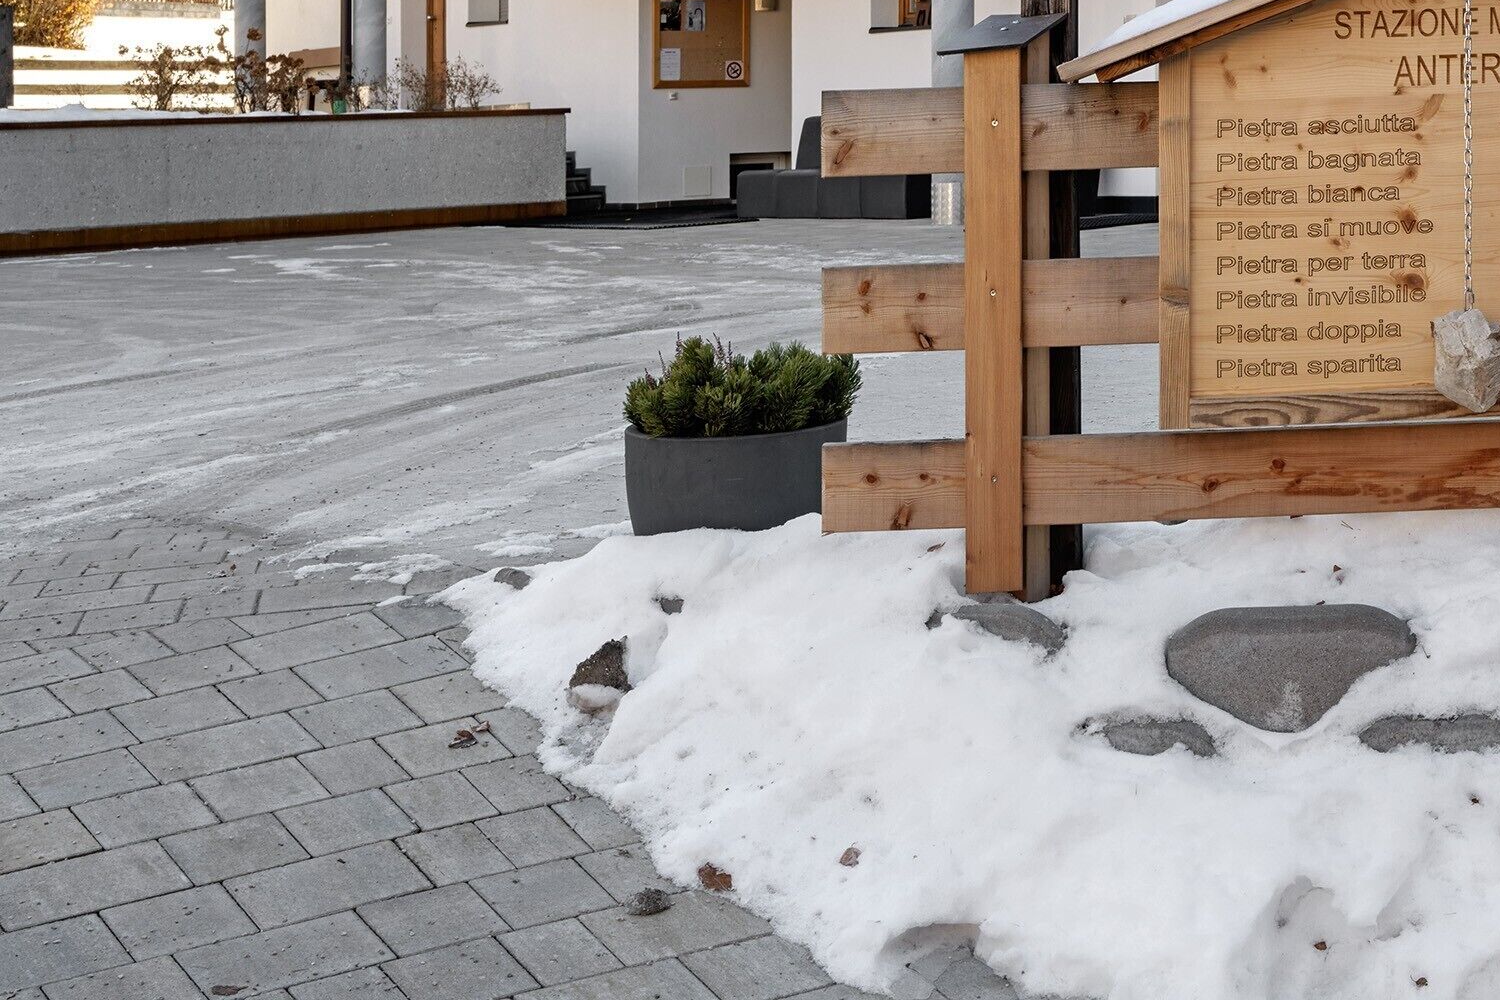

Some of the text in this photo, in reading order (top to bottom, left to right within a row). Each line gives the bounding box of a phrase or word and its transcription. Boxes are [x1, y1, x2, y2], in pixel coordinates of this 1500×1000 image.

[1334, 7, 1479, 40] STAZIONE
[1216, 114, 1416, 138] Pietra asciutta
[1216, 148, 1422, 172] Pietra bagnata
[1216, 183, 1400, 206] Pietra bianca
[1216, 217, 1434, 241] Pietra si muove
[1216, 252, 1427, 276] Pietra per terra
[1216, 285, 1427, 309] Pietra invisibile
[1216, 320, 1402, 344] Pietra doppia
[1216, 354, 1401, 378] Pietra sparita
